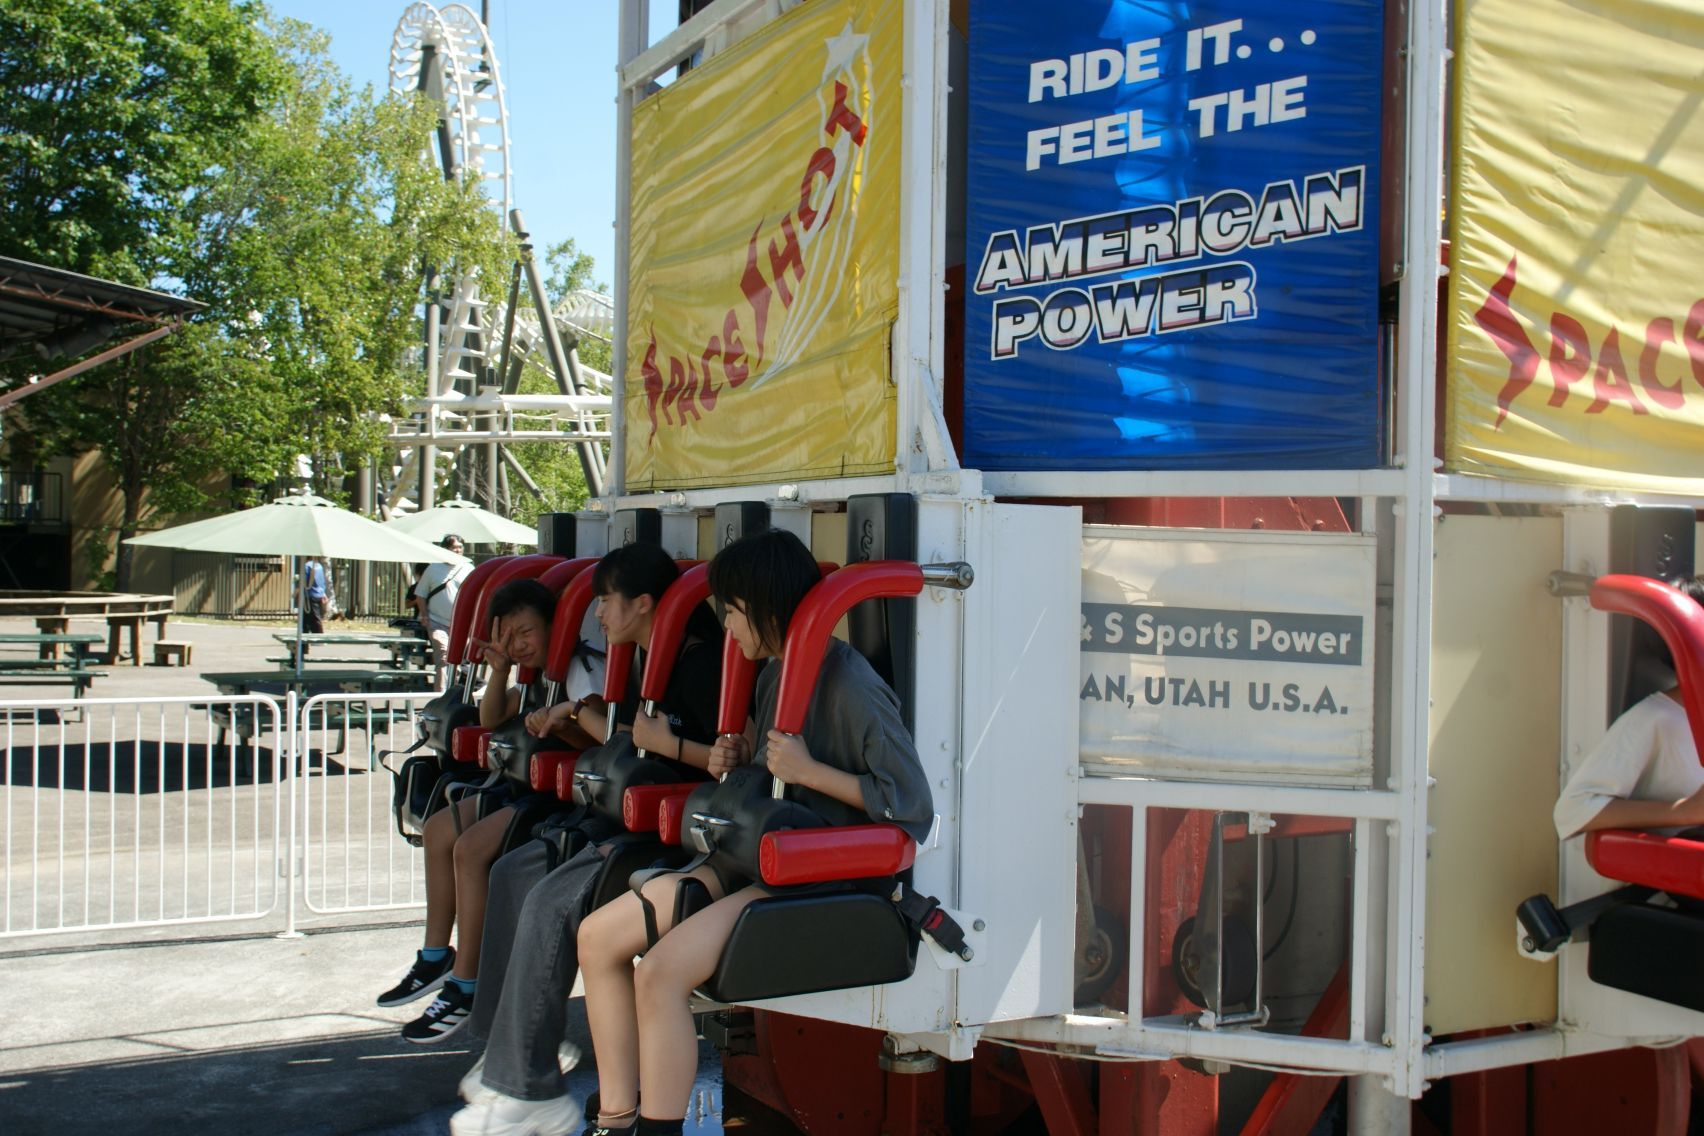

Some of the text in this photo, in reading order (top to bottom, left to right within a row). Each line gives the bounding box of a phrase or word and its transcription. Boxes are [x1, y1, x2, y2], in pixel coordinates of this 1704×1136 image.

[1028, 37, 1161, 104] RIDE
[1026, 75, 1308, 171] FEEL THE
[973, 164, 1366, 294] AMERICAN
[991, 261, 1257, 361] POWER
[1104, 611, 1124, 644] S
[1135, 612, 1239, 655] Sports
[1250, 618, 1352, 655] Power
[1144, 676, 1230, 709] UTAH
[1248, 681, 1349, 715] U.S.A.
